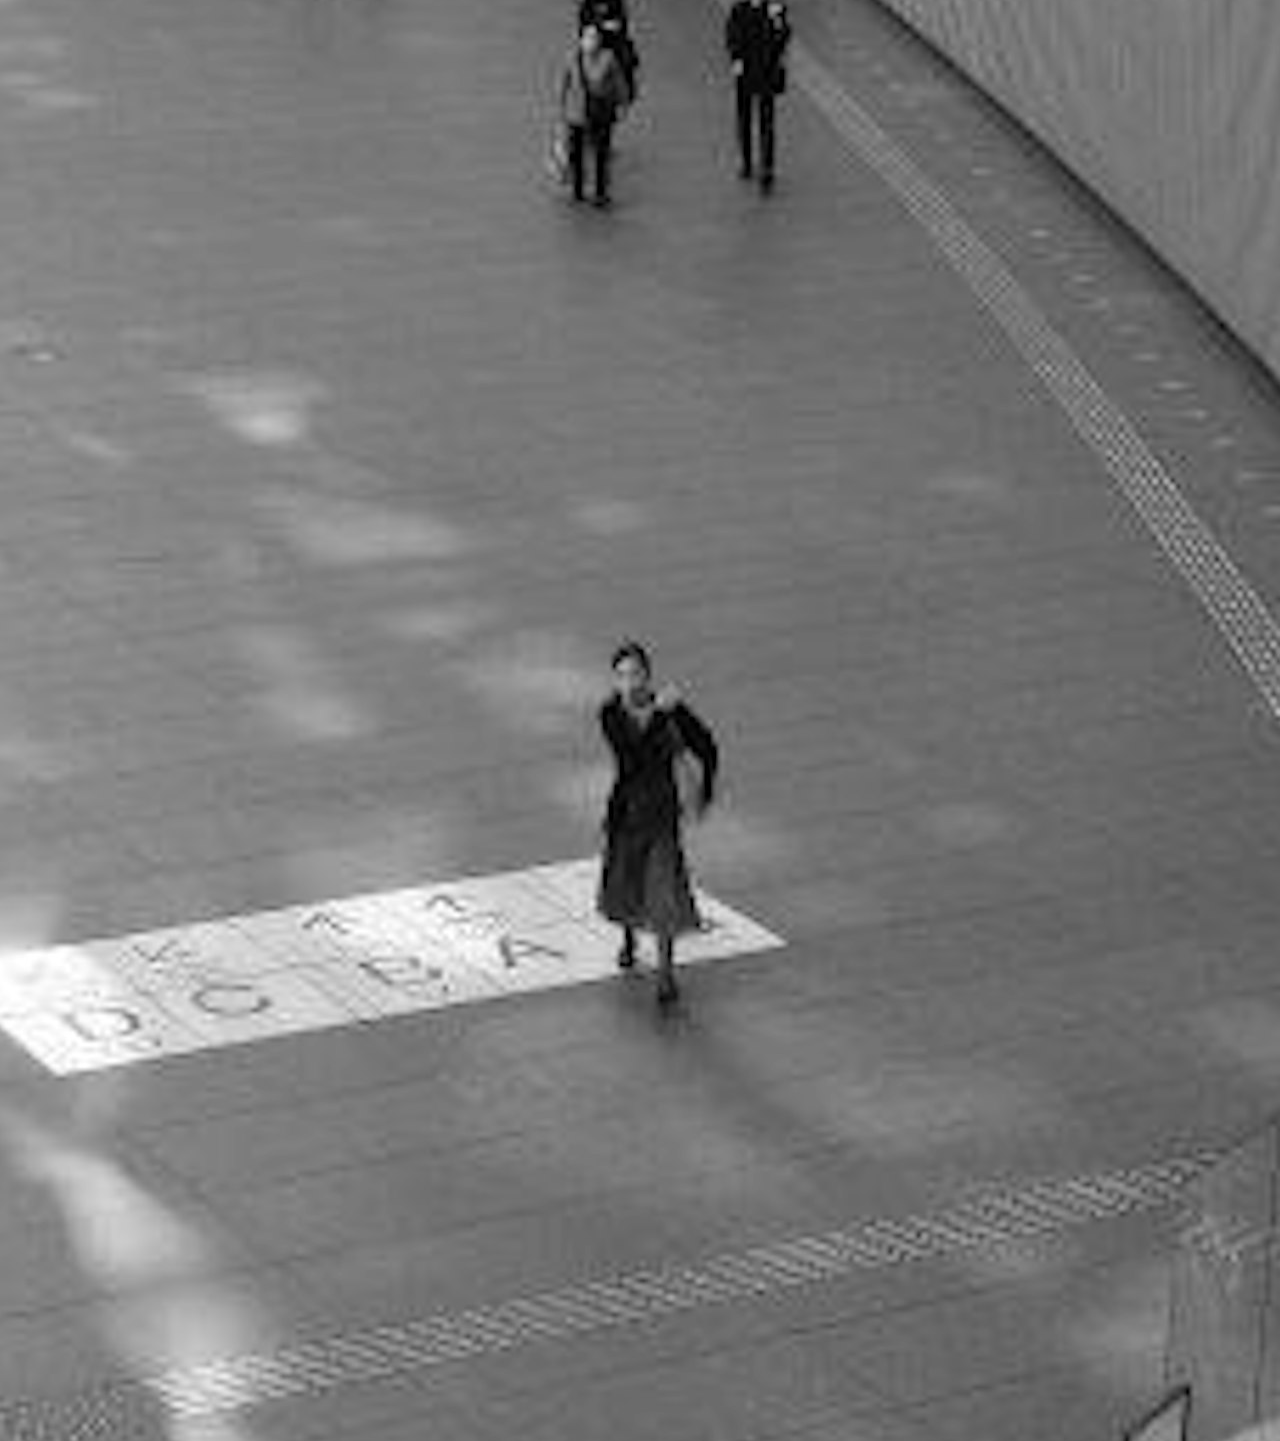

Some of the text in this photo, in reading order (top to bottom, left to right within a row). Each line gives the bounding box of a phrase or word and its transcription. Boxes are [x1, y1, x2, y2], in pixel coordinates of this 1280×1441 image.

[64, 1005, 142, 1042] D
[190, 982, 272, 1018] C
[496, 934, 568, 970] A
